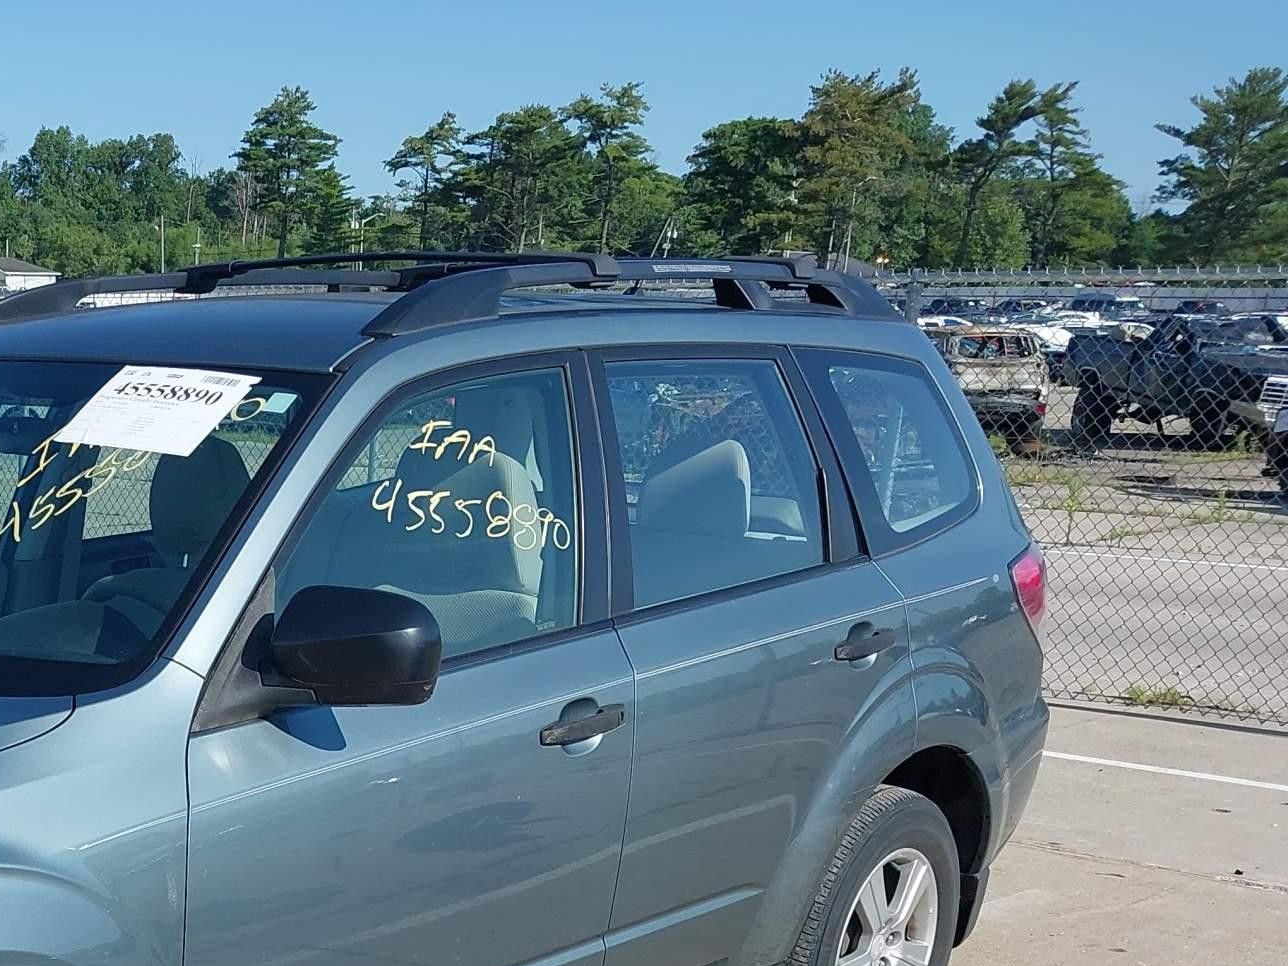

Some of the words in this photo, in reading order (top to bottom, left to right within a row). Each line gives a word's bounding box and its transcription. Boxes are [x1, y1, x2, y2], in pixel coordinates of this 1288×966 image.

[114, 381, 223, 406] 45558890
[409, 419, 497, 468] IAA
[371, 477, 571, 550] 45558890
